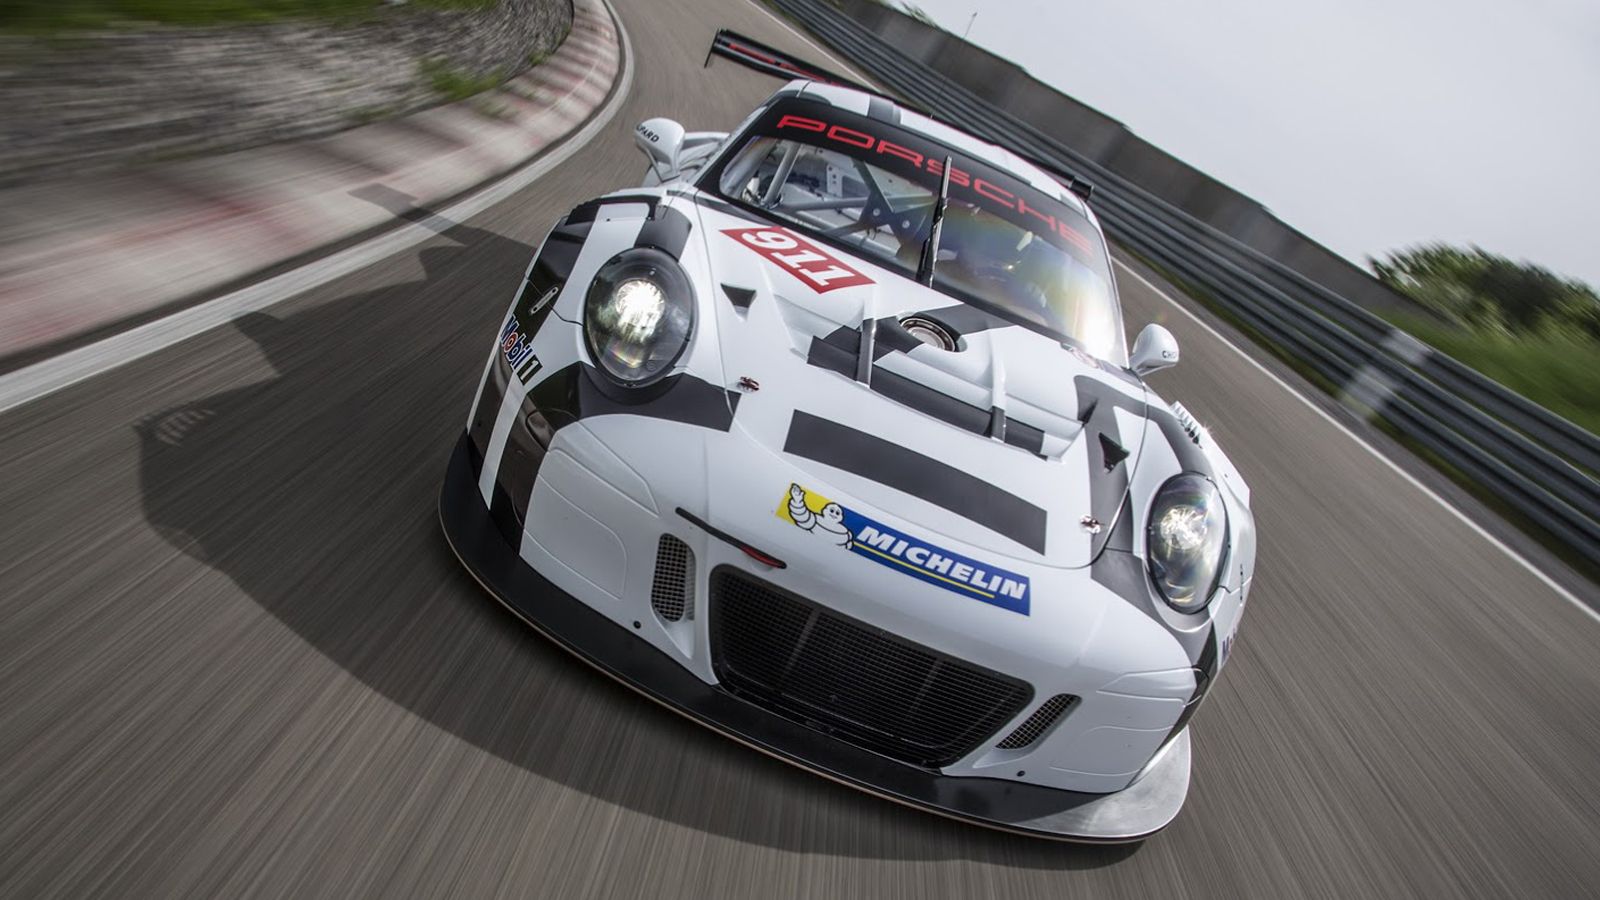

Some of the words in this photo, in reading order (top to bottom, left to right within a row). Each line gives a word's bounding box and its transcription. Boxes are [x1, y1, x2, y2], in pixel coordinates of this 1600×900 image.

[776, 114, 1094, 258] PORSCHE
[741, 231, 856, 286] 911
[501, 314, 534, 371] Mobil
[856, 526, 1027, 600] MICHELIN
